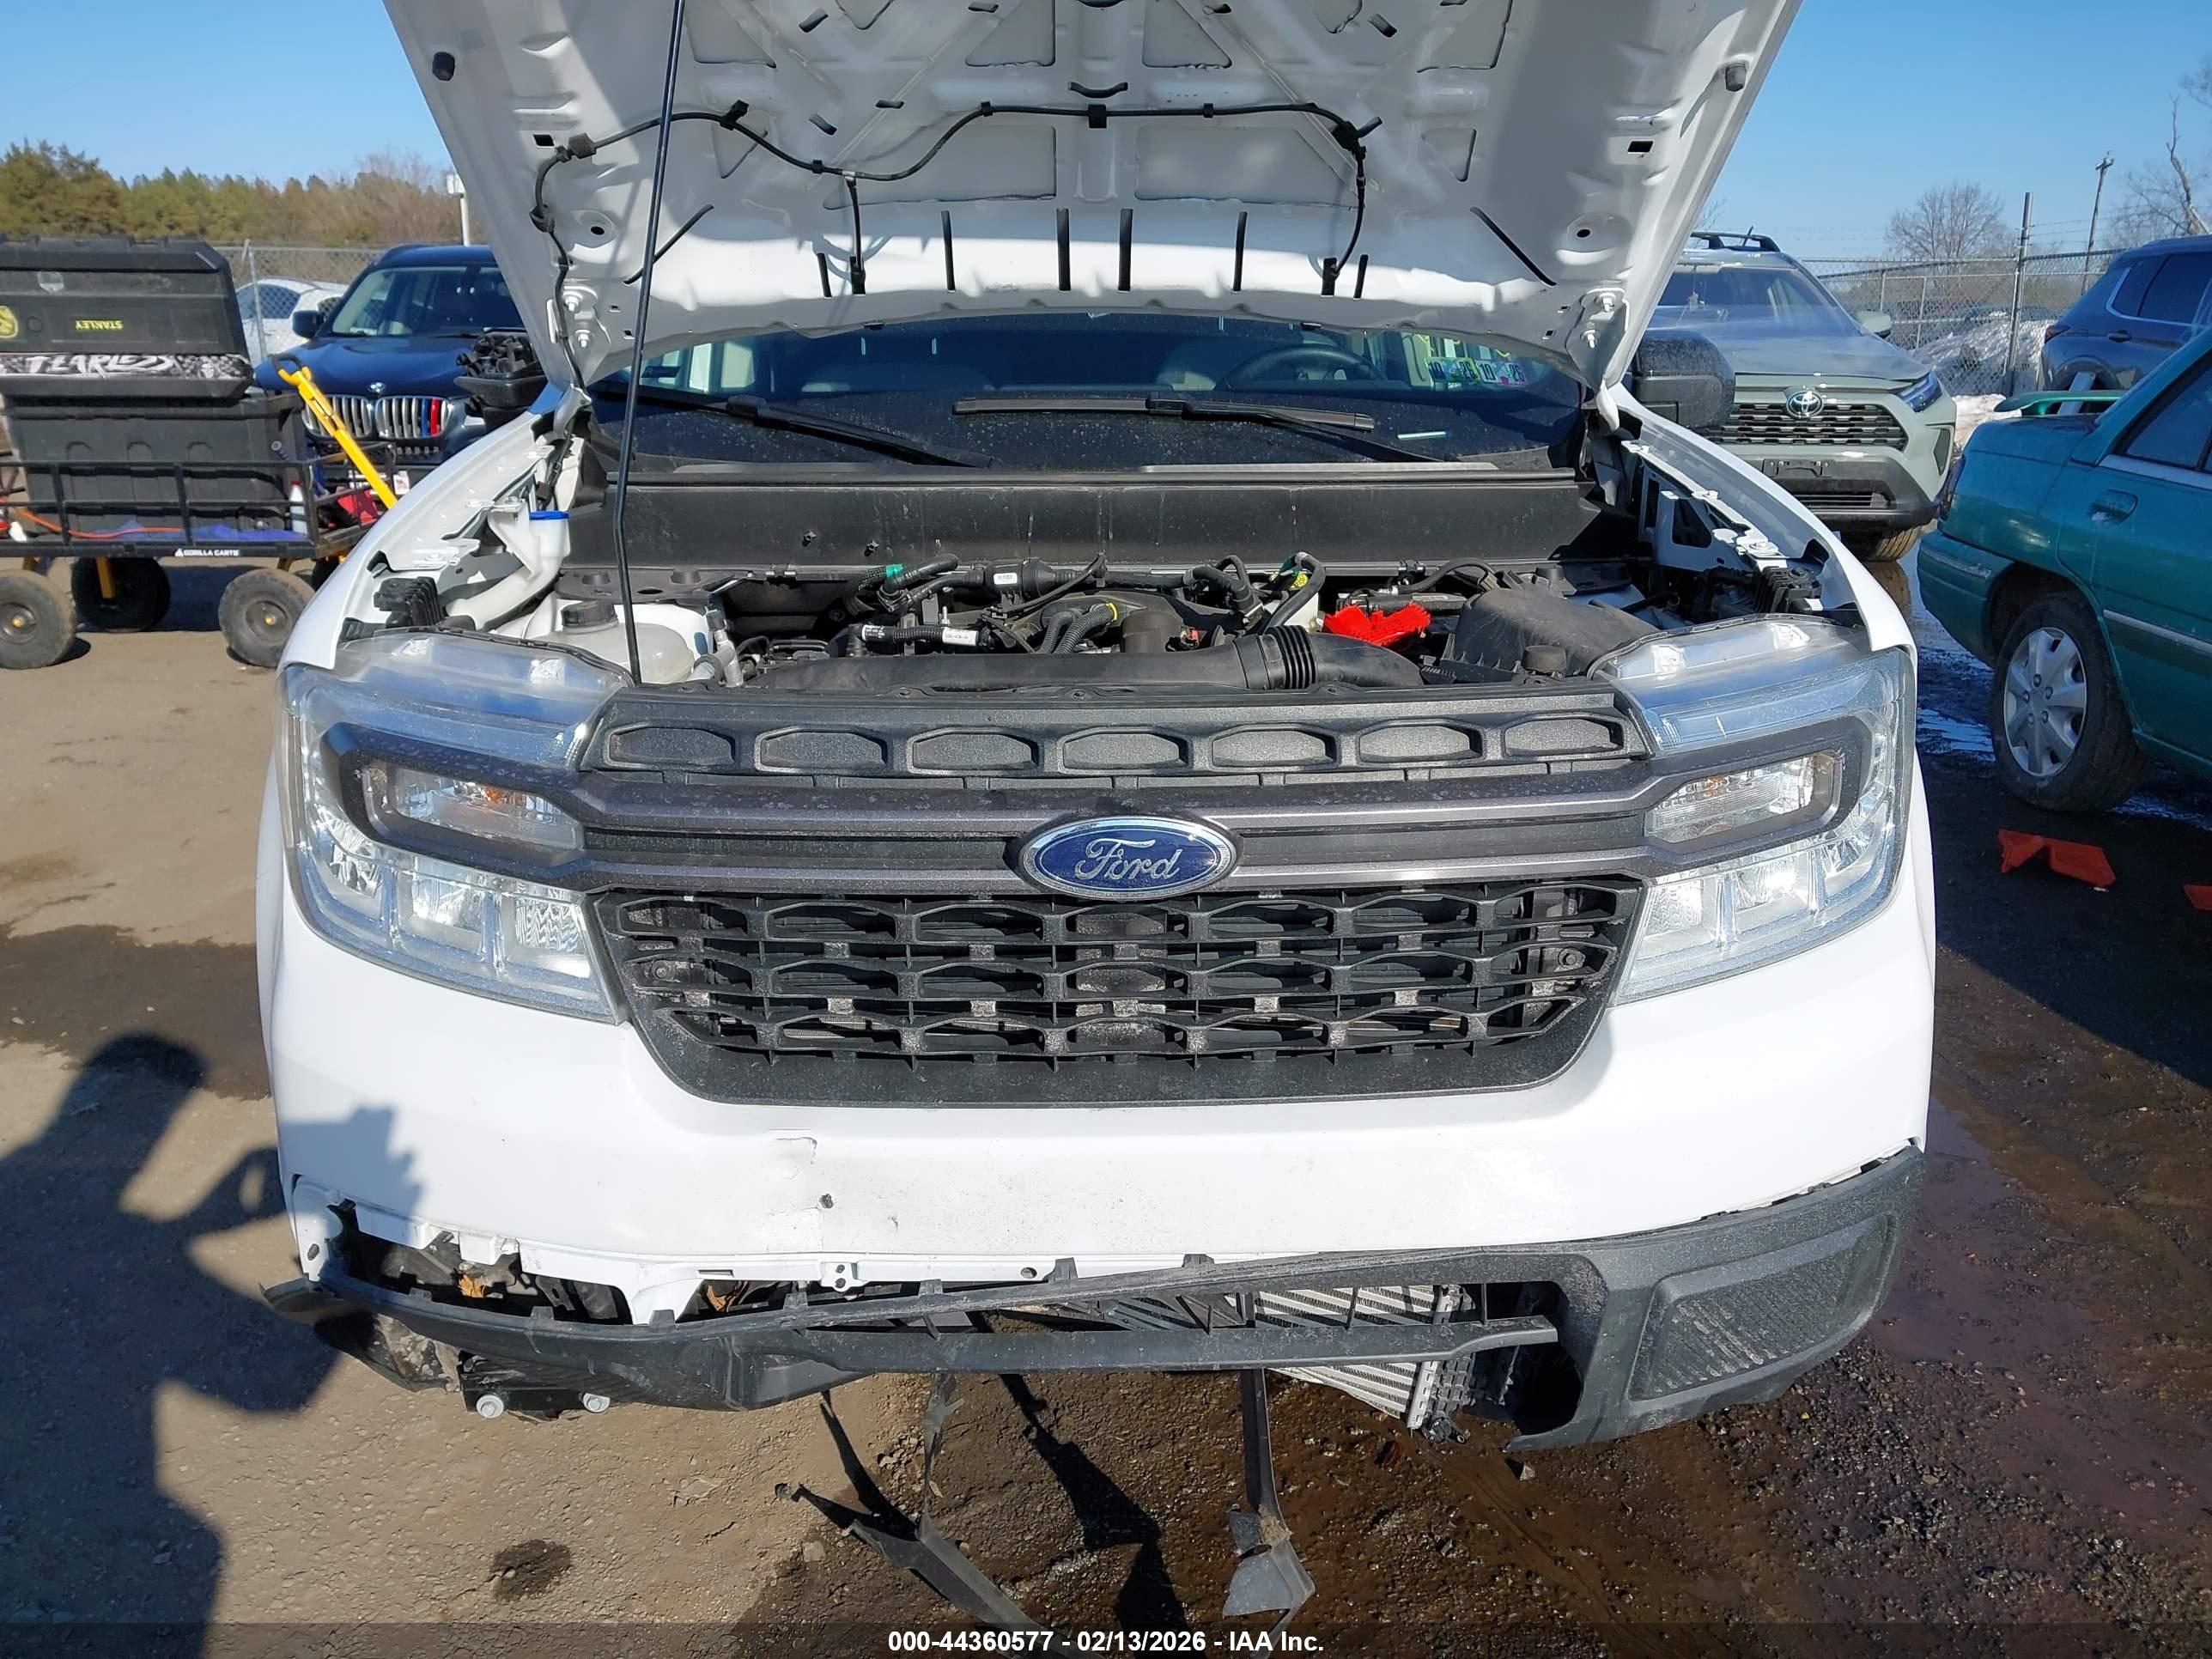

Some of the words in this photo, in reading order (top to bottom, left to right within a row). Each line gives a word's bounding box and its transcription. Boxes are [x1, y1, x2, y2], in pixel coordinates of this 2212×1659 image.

[75, 319, 124, 331] STANLEY
[1480, 363, 1496, 380] 10
[1074, 838, 1183, 880] Ford
